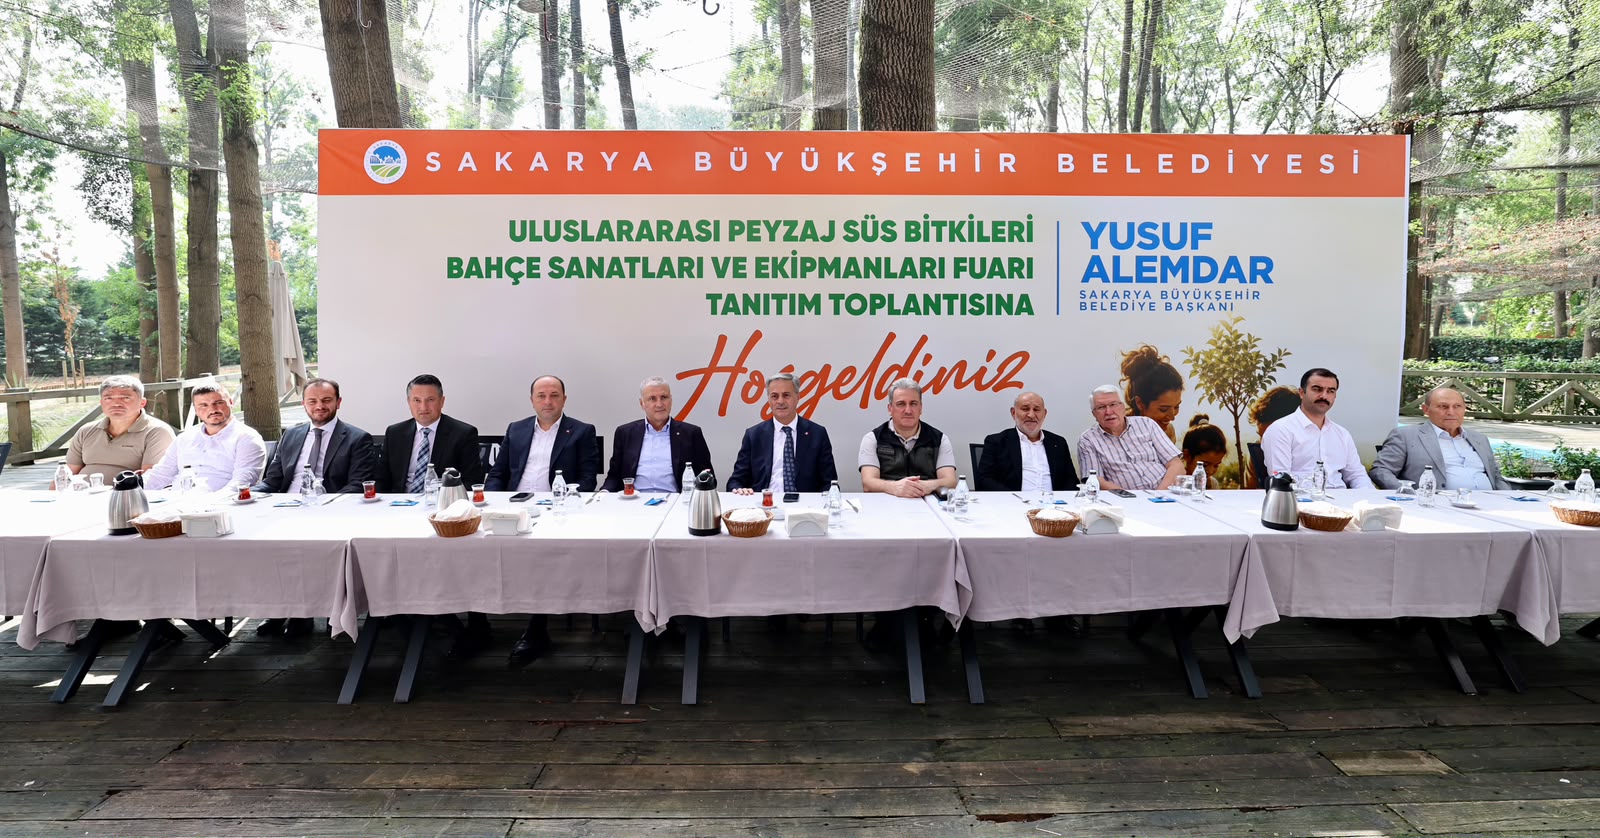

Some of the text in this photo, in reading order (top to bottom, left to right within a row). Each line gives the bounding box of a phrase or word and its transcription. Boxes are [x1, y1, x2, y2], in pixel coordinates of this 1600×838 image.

[425, 151, 653, 172] SAKARYA
[694, 147, 1017, 177] BÜYÜKŞEHİR
[1057, 149, 1359, 174] BELEDİYESİ
[510, 214, 1034, 243] ULUSLARARASI PEYZAJ SÜS BİTKİLERİ
[1081, 221, 1214, 250] YUSUF
[448, 251, 1034, 286] BAHÇE SANATLARI VE EKİPMANLARI FUARI
[1081, 255, 1274, 284] ALEMDAR
[707, 294, 1034, 316] TANITIM TOPLANTISINA
[1080, 288, 1261, 302] SAKARYA BÜYÜKŞEHİR
[1080, 301, 1234, 313] BELEDİYE BAŞKANI
